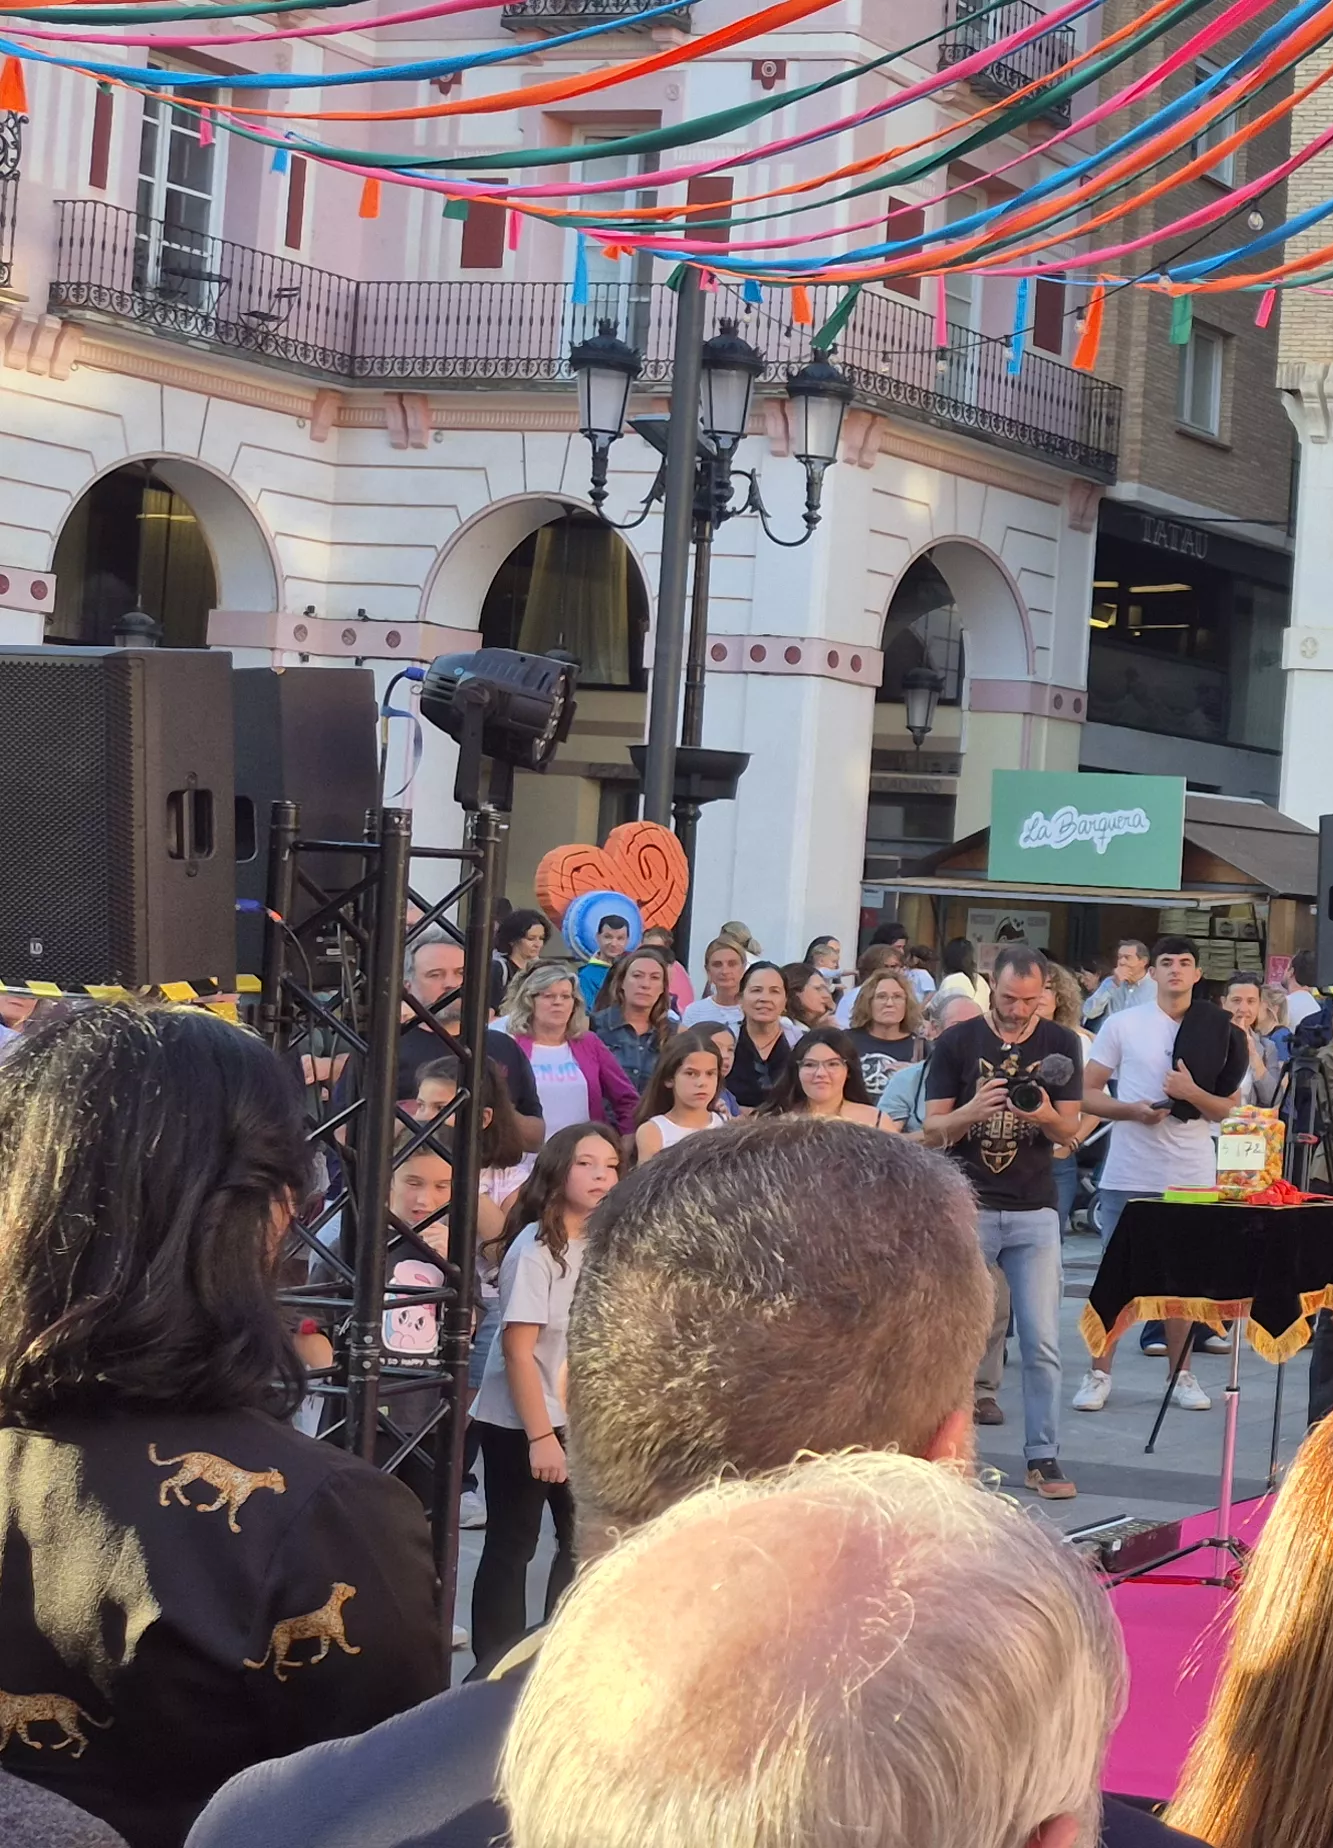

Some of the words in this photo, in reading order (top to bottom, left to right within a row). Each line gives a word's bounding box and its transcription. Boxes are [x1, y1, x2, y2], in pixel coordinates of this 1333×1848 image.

[1142, 516, 1208, 559] TATAU
[1022, 817, 1052, 842] La
[1053, 811, 1145, 847] Barquera
